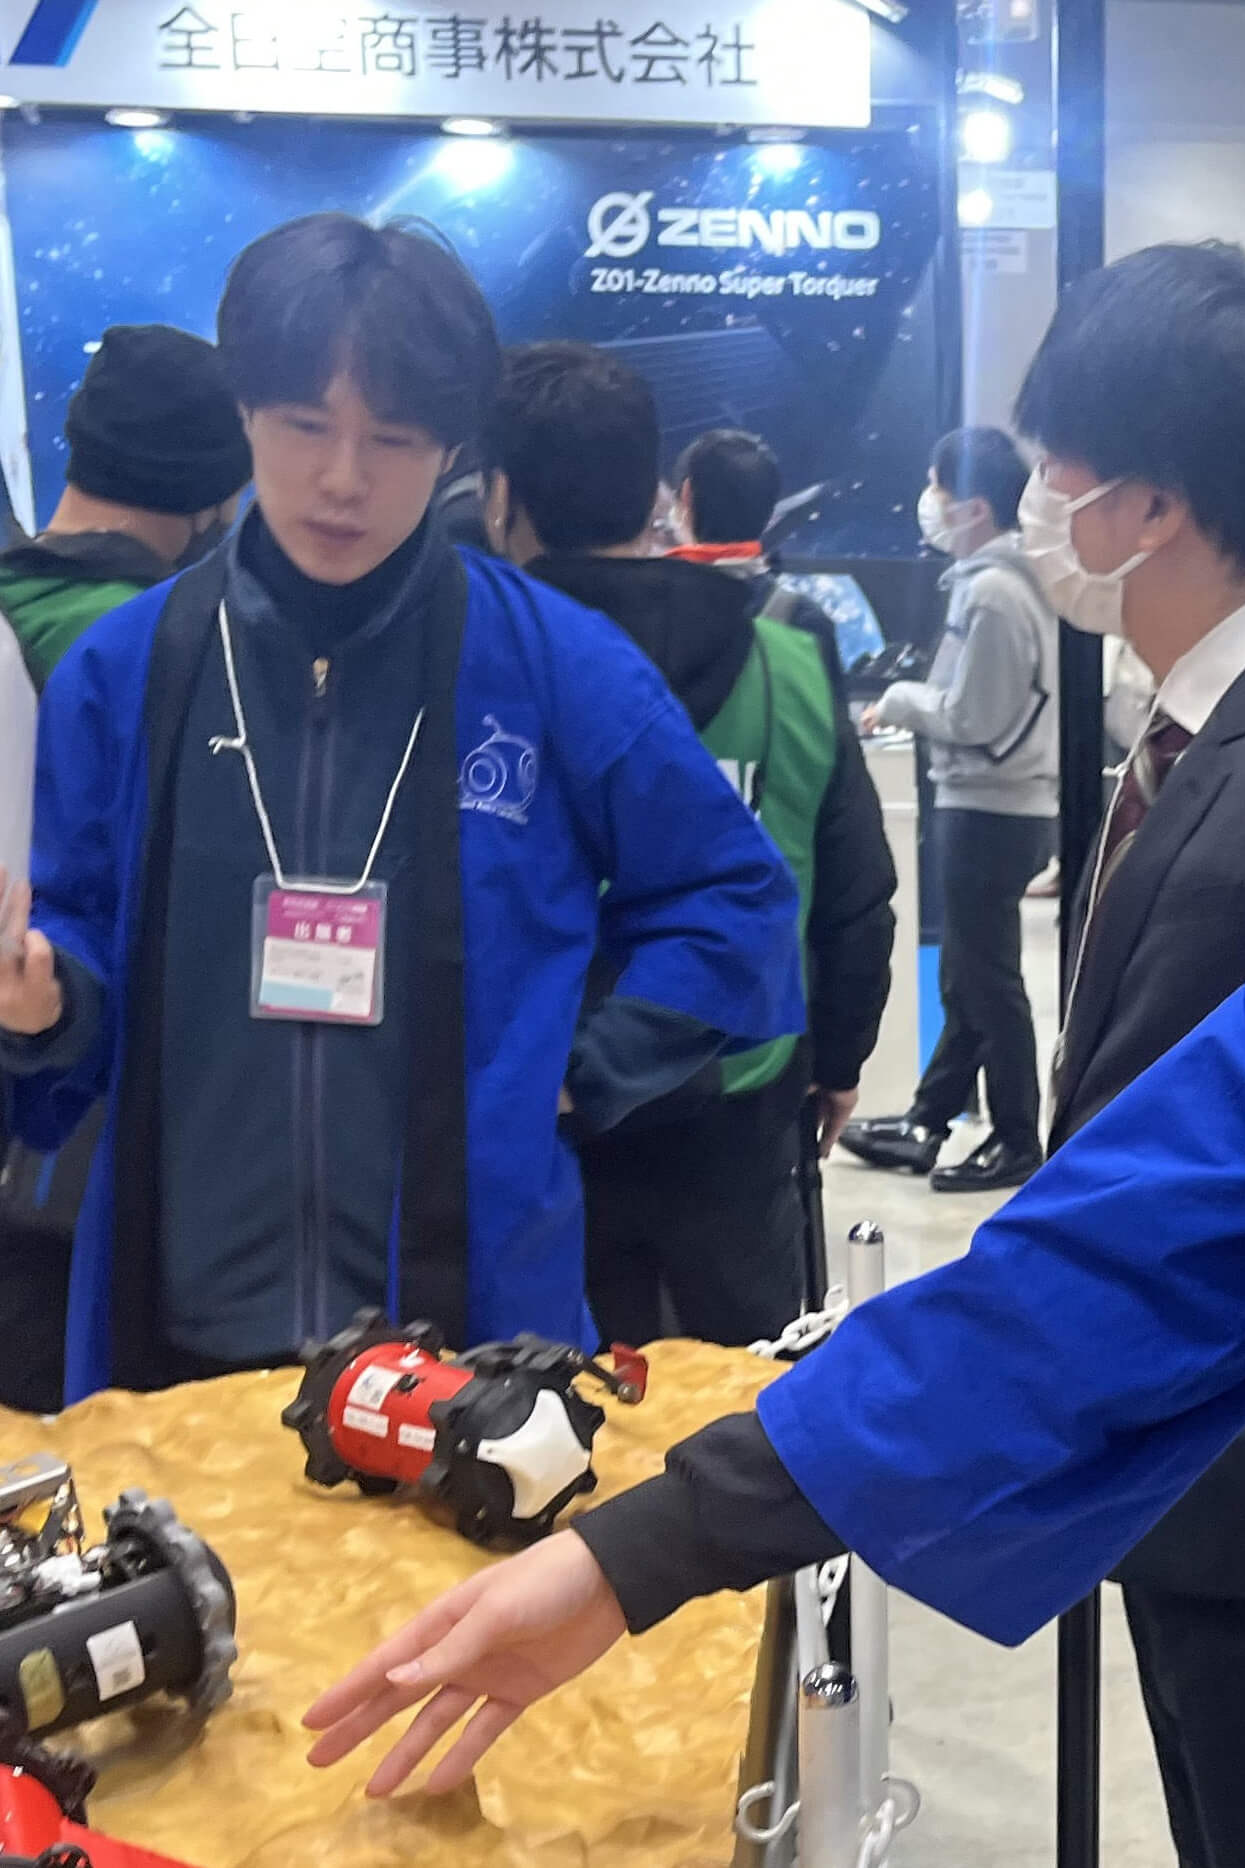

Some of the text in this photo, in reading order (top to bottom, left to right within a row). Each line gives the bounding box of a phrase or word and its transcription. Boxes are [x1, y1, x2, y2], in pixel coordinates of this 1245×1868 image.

[656, 207, 880, 251] ZENNO
[589, 267, 880, 300] Z01-Zenno Super Torquer
